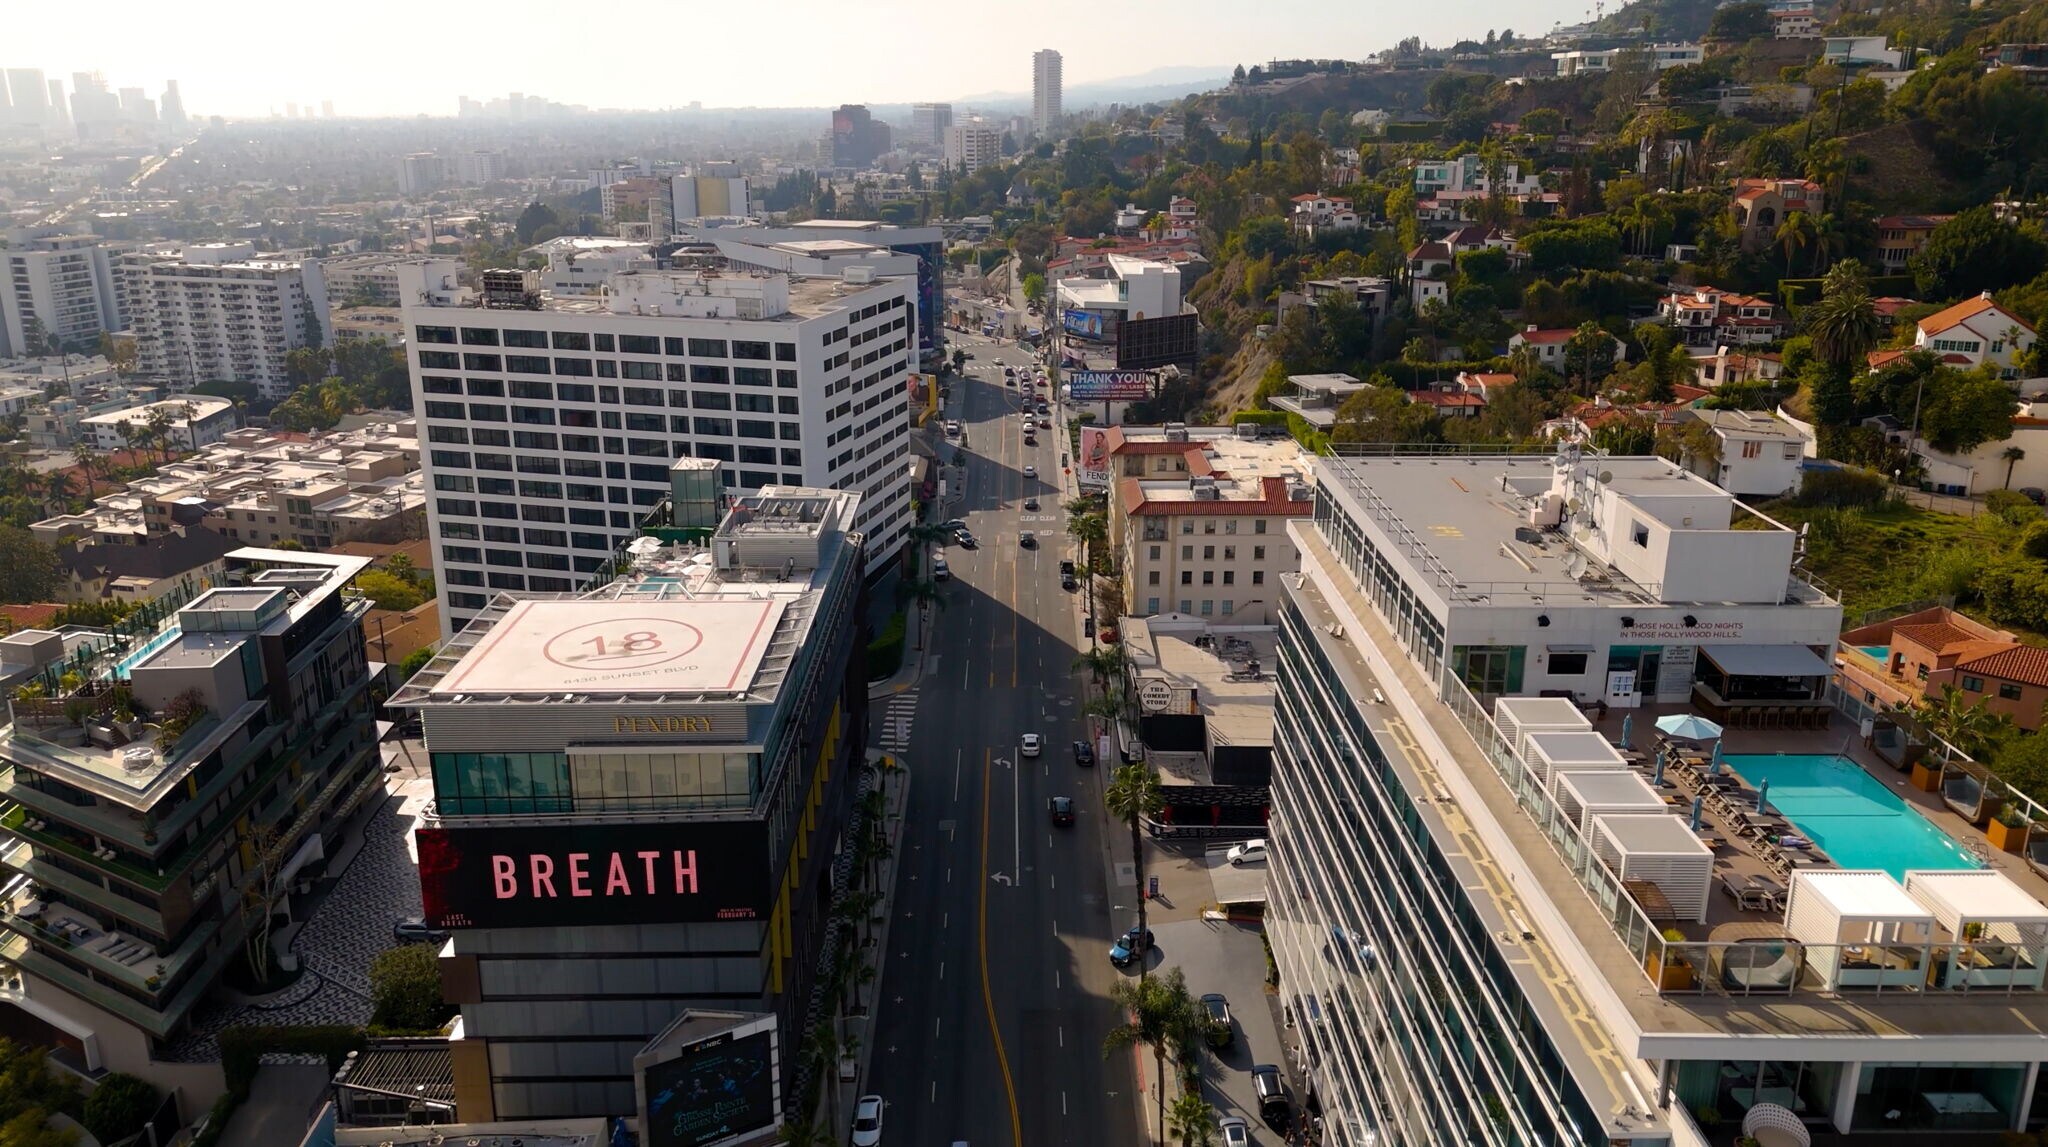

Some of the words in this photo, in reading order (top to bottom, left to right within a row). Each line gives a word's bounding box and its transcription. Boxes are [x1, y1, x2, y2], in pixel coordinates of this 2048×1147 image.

[1072, 373, 1113, 384] THANK
[1115, 373, 1145, 384] YOU!
[1632, 622, 1657, 630] THOSE
[1714, 622, 1744, 630] NIGHTS
[581, 631, 663, 657] 18
[601, 669, 660, 680] SUNSET
[664, 664, 699, 674] BLVD
[614, 715, 713, 733] PENDRY
[492, 850, 699, 899] BREATH
[717, 911, 747, 919] FEBRUARY
[441, 919, 472, 927] BREATH
[706, 1039, 722, 1048] NBC
[673, 1117, 711, 1136] GARDEN
[712, 1103, 752, 1123] SOCIETY
